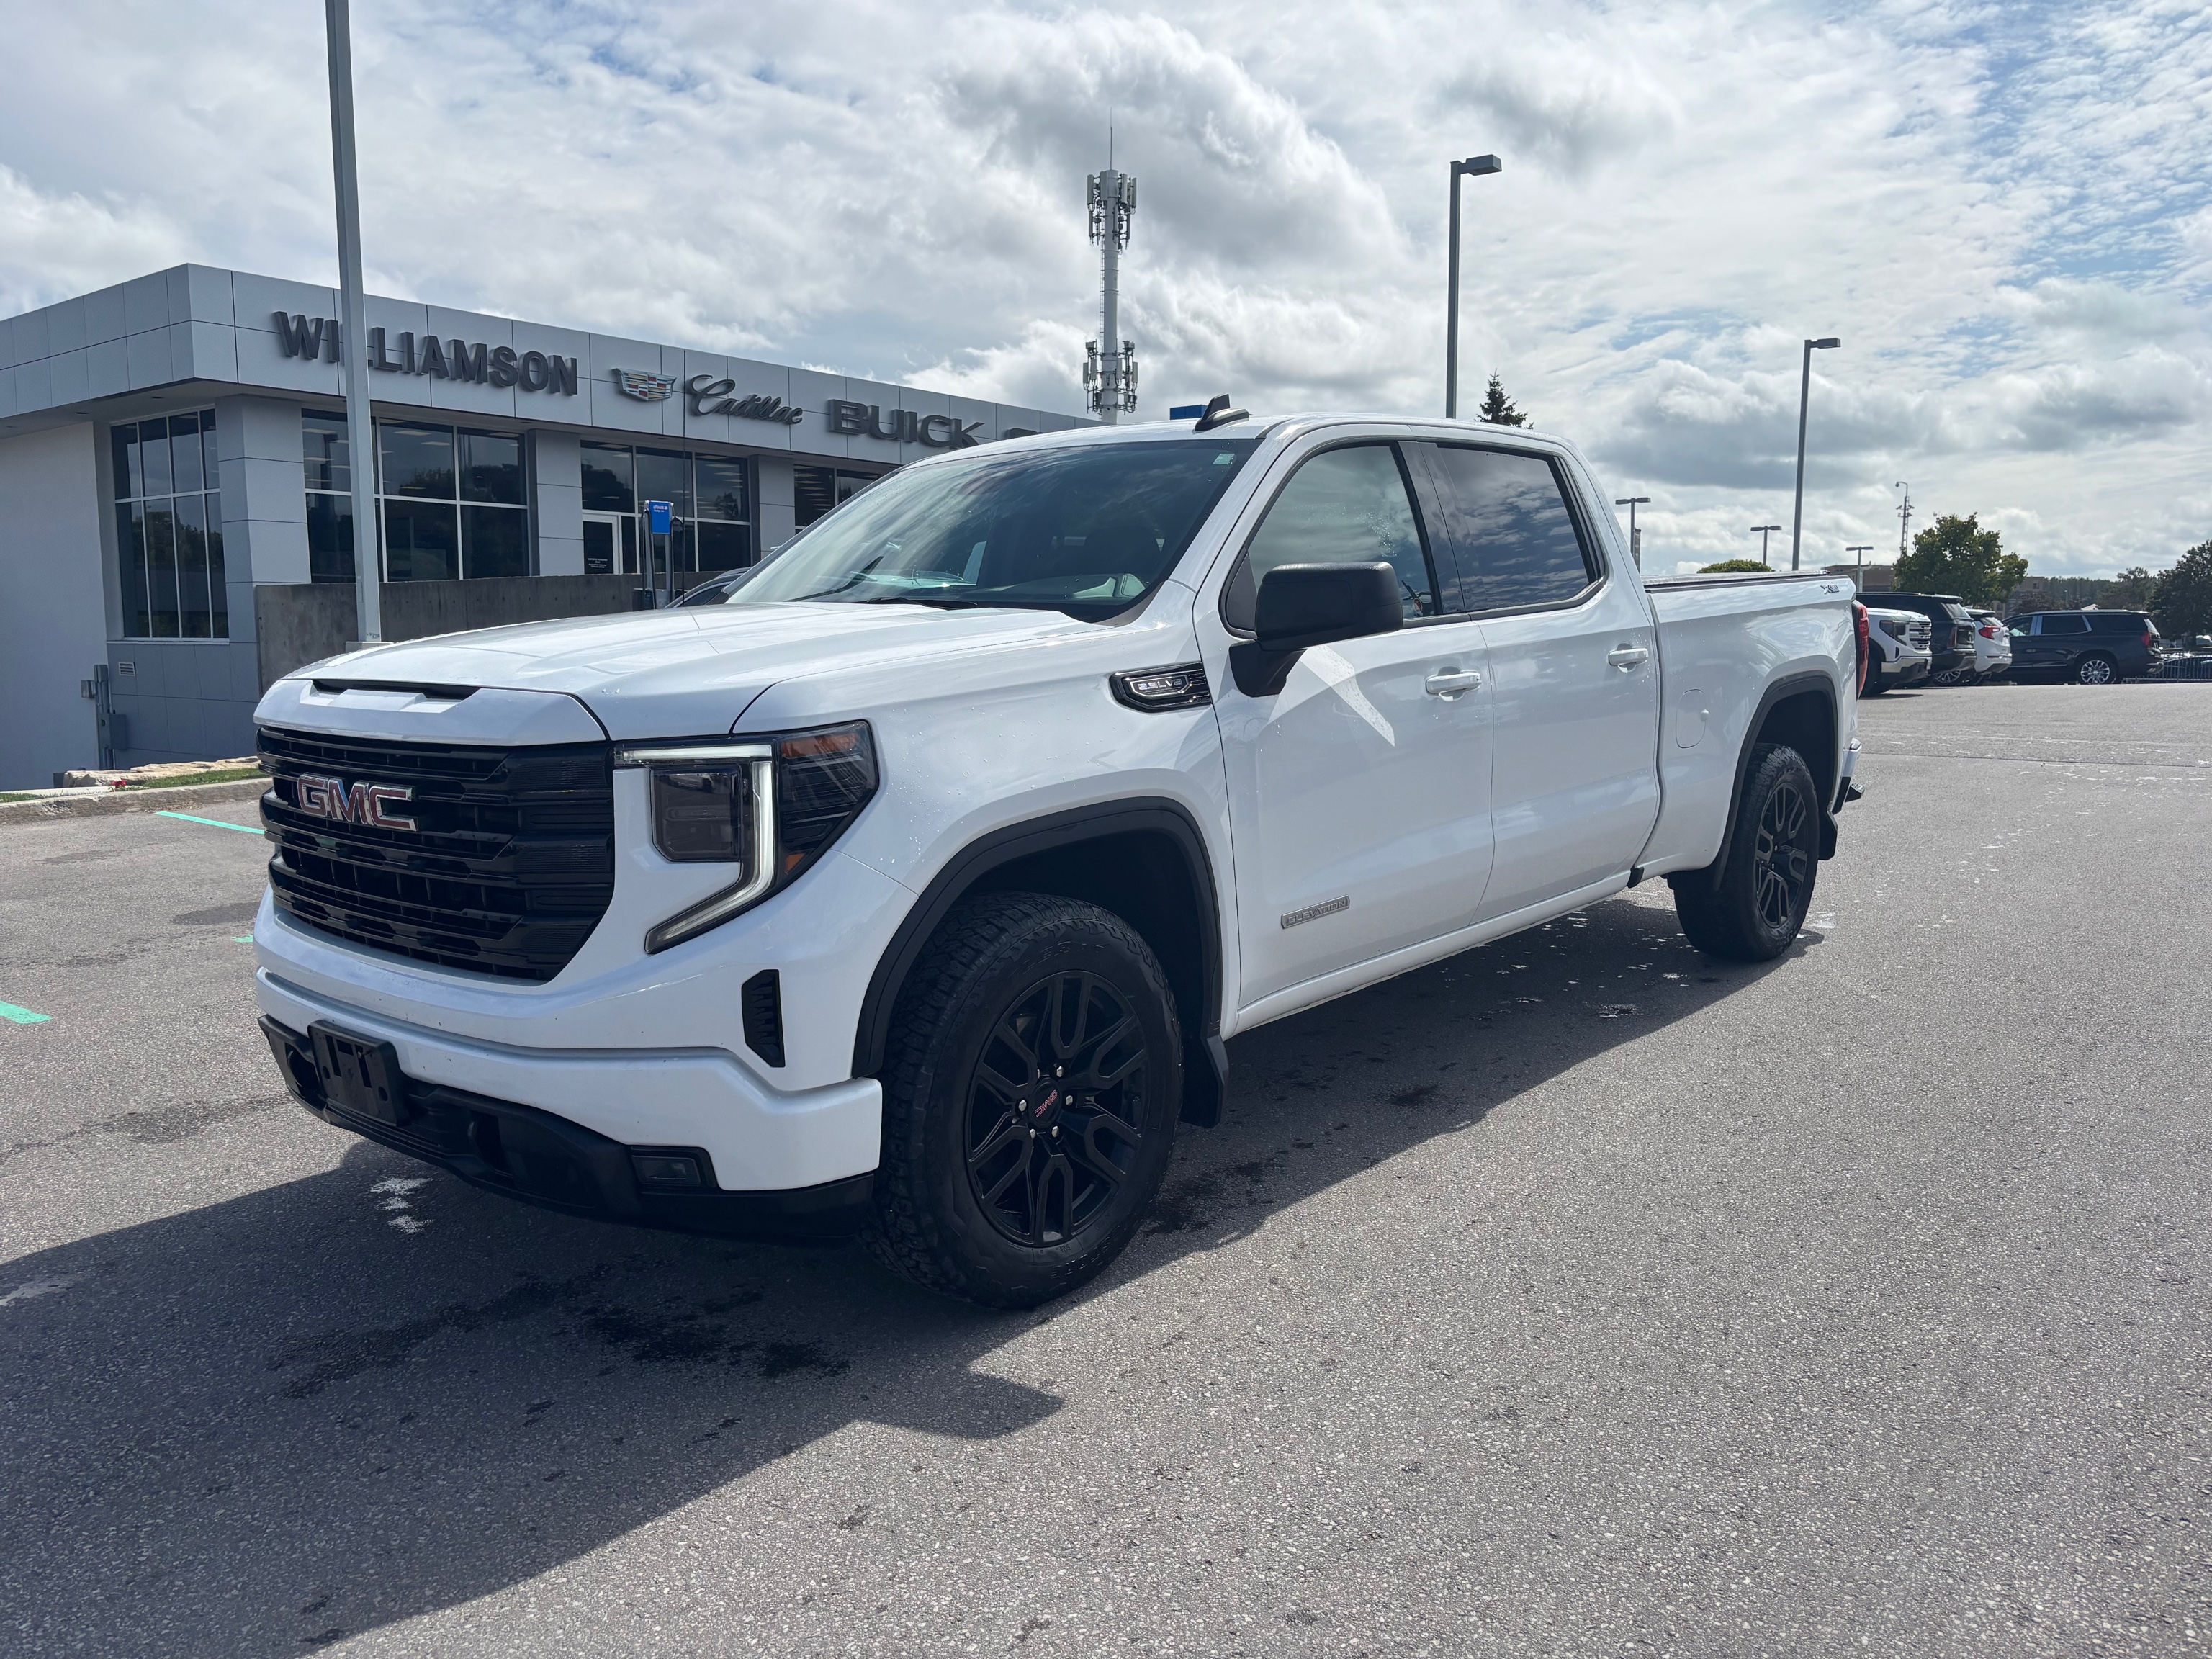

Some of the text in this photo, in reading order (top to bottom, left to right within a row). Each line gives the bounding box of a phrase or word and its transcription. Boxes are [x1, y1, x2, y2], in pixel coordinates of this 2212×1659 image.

[274, 311, 577, 395] WILIAMSON
[685, 374, 803, 425] Cadillac
[828, 398, 985, 449] BUICK
[297, 772, 418, 832] GMC
[1287, 899, 1346, 925] ELEVATION
[1034, 1089, 1058, 1118] GMC
